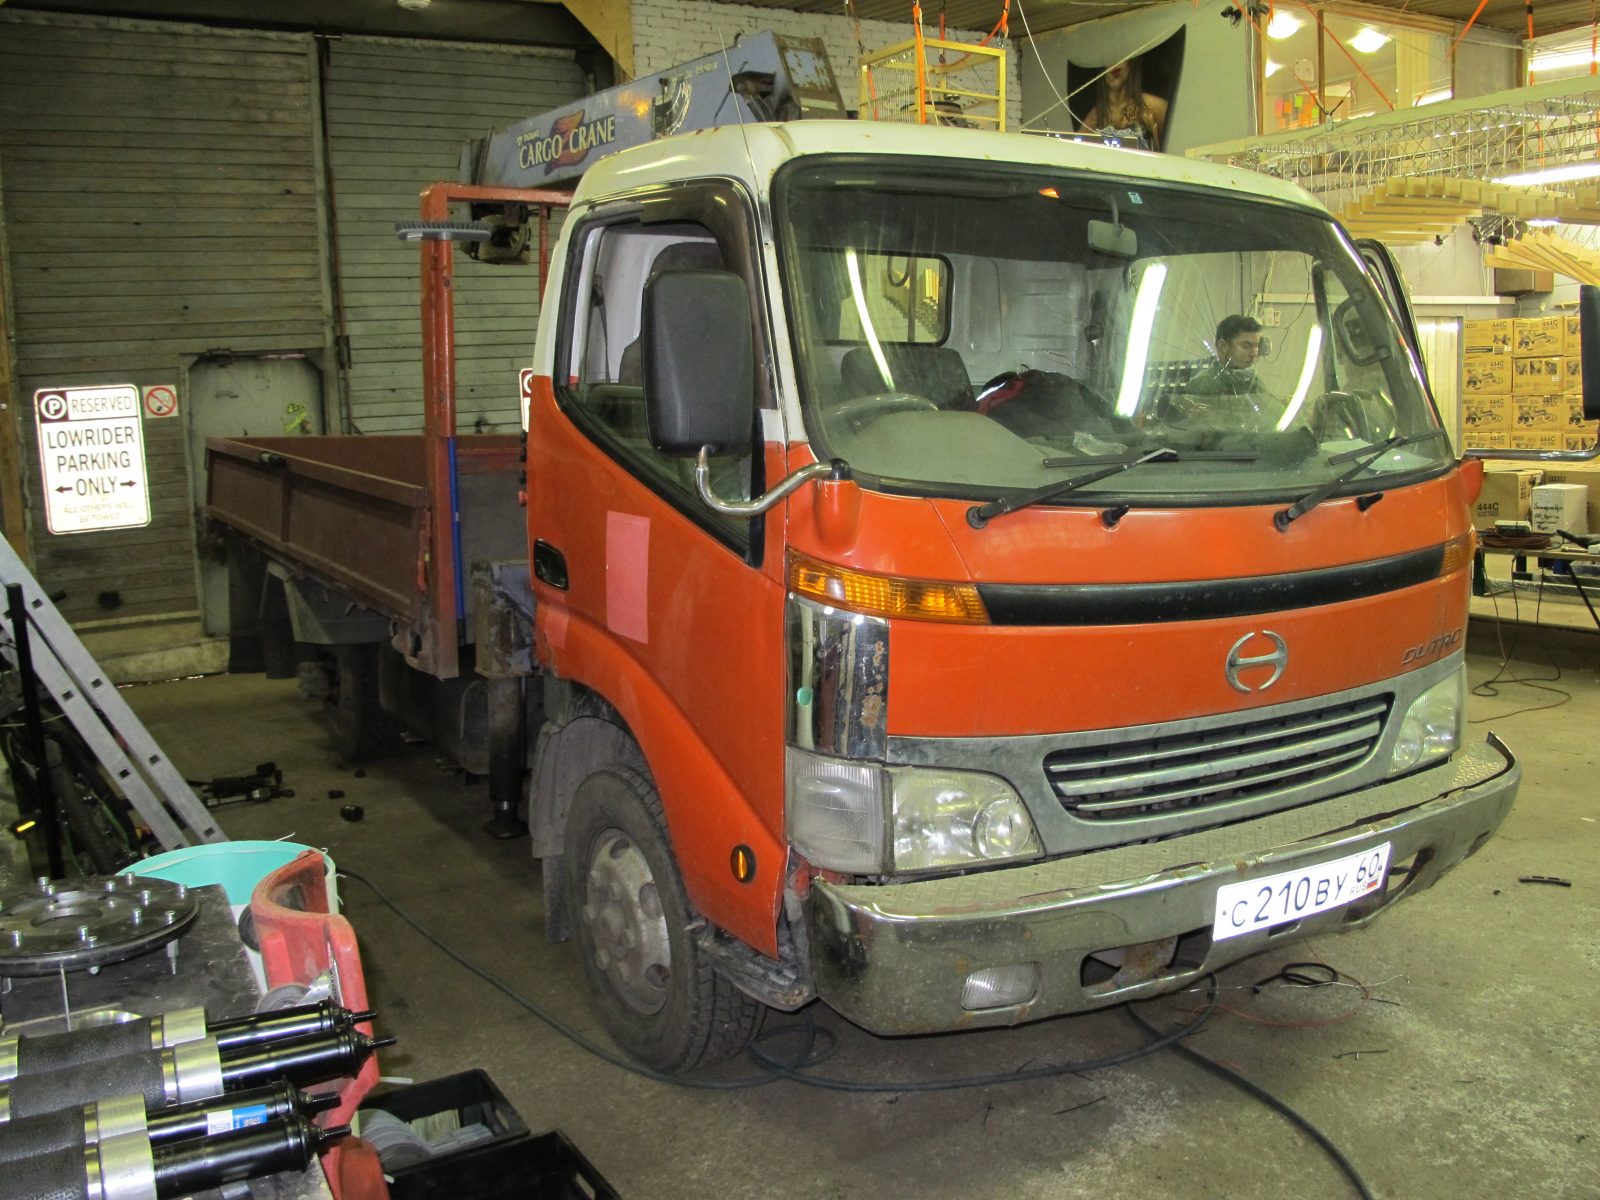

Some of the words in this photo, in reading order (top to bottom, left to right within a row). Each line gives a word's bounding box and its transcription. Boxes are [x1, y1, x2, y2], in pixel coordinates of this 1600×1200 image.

[519, 134, 563, 169] CARGO
[569, 115, 615, 154] CRANE
[71, 395, 132, 413] RESERVED
[47, 426, 135, 449] LOWRIDER
[57, 450, 131, 473] PARKING
[76, 476, 117, 496] ONLY
[1477, 502, 1499, 511] 444C
[1401, 627, 1461, 664] DUTRO
[1356, 852, 1380, 883] 60
[1350, 881, 1367, 896] RUS
